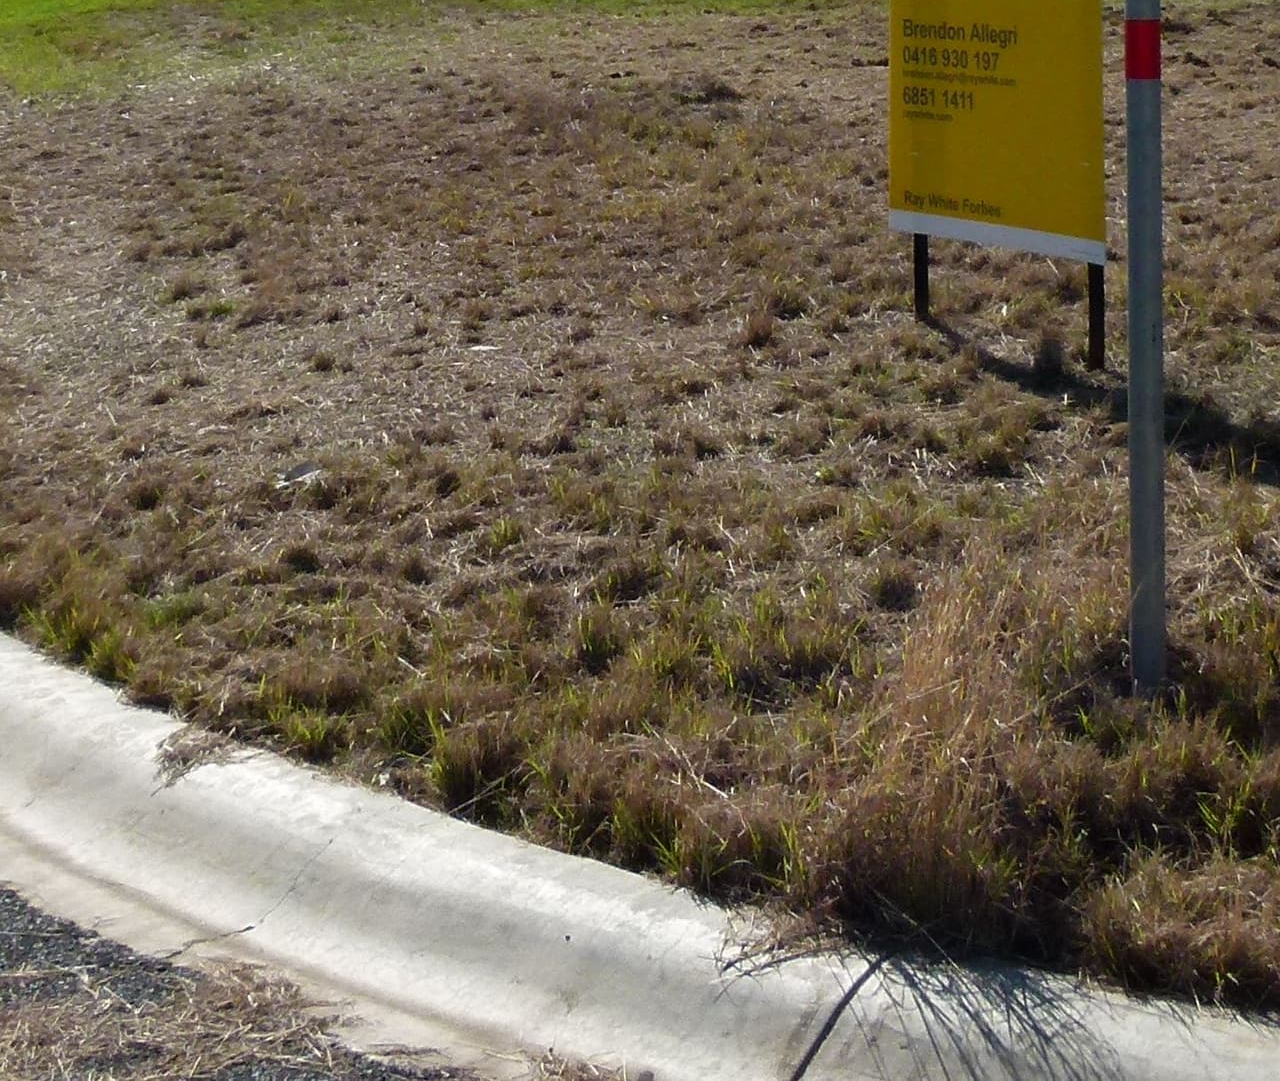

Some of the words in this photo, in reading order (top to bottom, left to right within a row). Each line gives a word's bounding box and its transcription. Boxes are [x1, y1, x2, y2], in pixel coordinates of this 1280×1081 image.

[903, 19, 966, 40] Brendon
[970, 23, 1018, 49] Allegri
[903, 46, 937, 66] 0416
[941, 48, 969, 69] 930
[974, 51, 999, 71] 197
[903, 86, 936, 107] 6851
[942, 89, 974, 111] 1411
[904, 191, 925, 209] Ray
[929, 192, 959, 212] White
[962, 198, 1001, 217] Forbes
